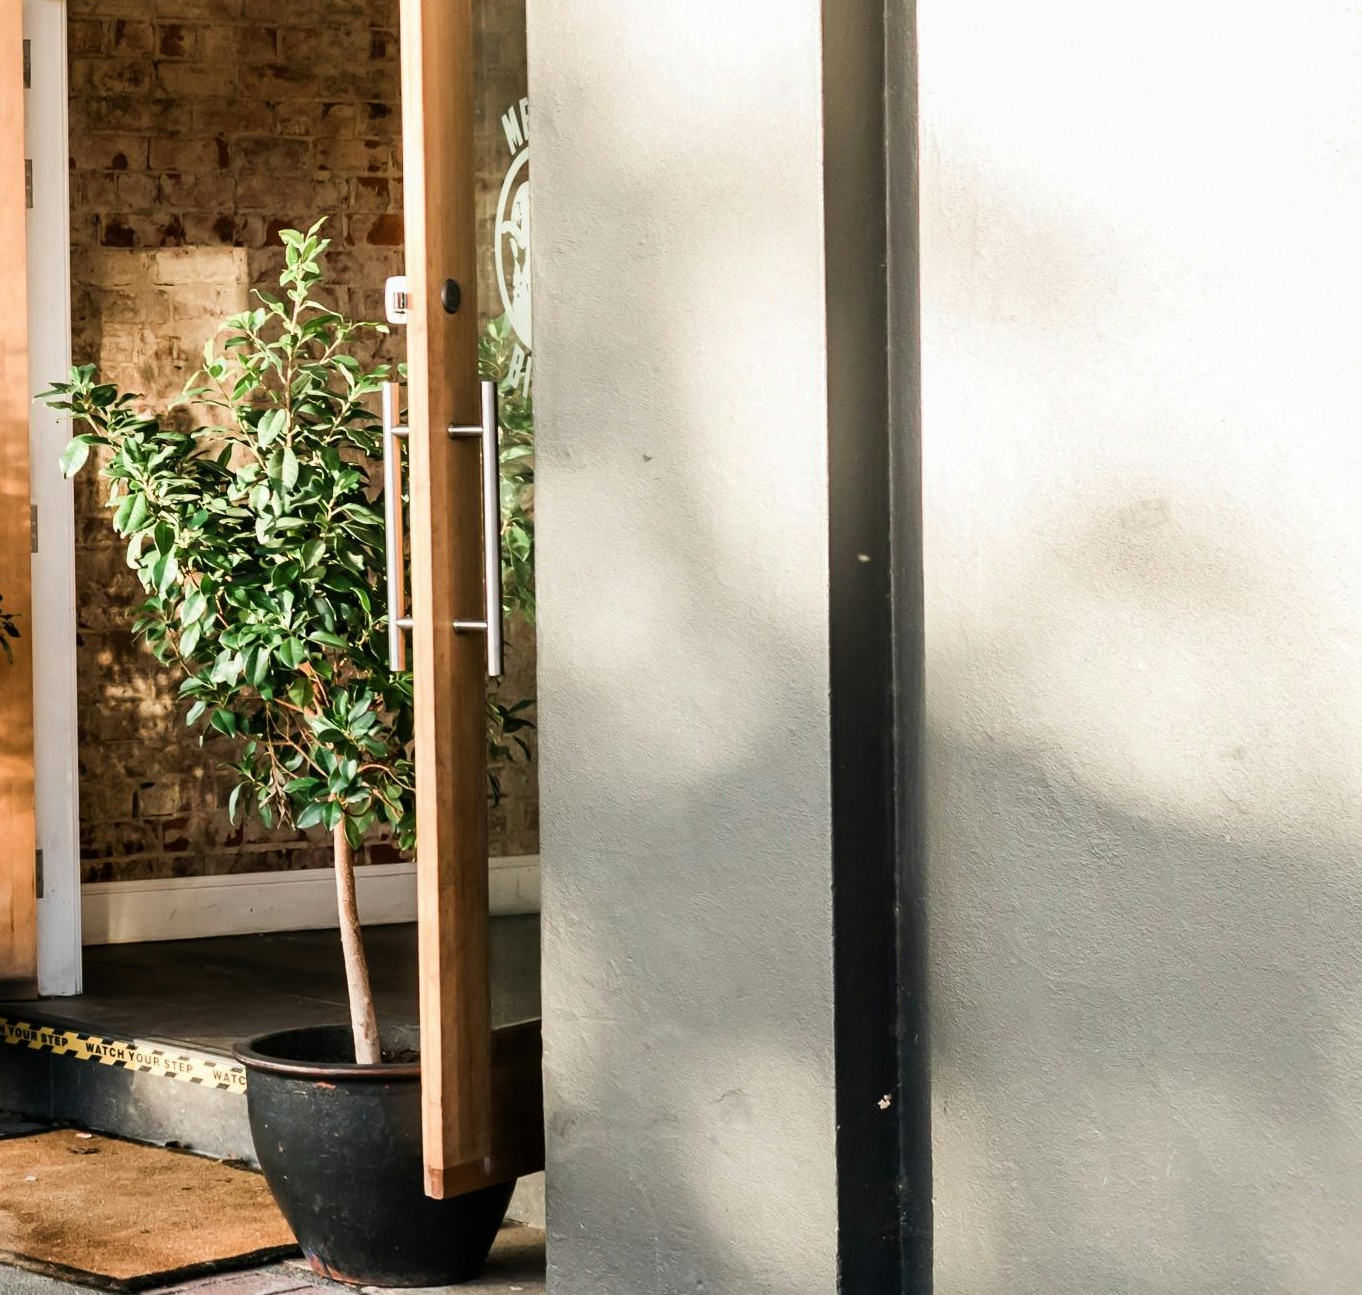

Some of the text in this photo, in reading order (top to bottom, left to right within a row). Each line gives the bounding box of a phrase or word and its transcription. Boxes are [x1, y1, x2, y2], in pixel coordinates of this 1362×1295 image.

[7, 1025, 39, 1042] YOUR
[40, 1032, 69, 1048] STEP
[85, 1042, 193, 1074] WATCH YOUR STEP
